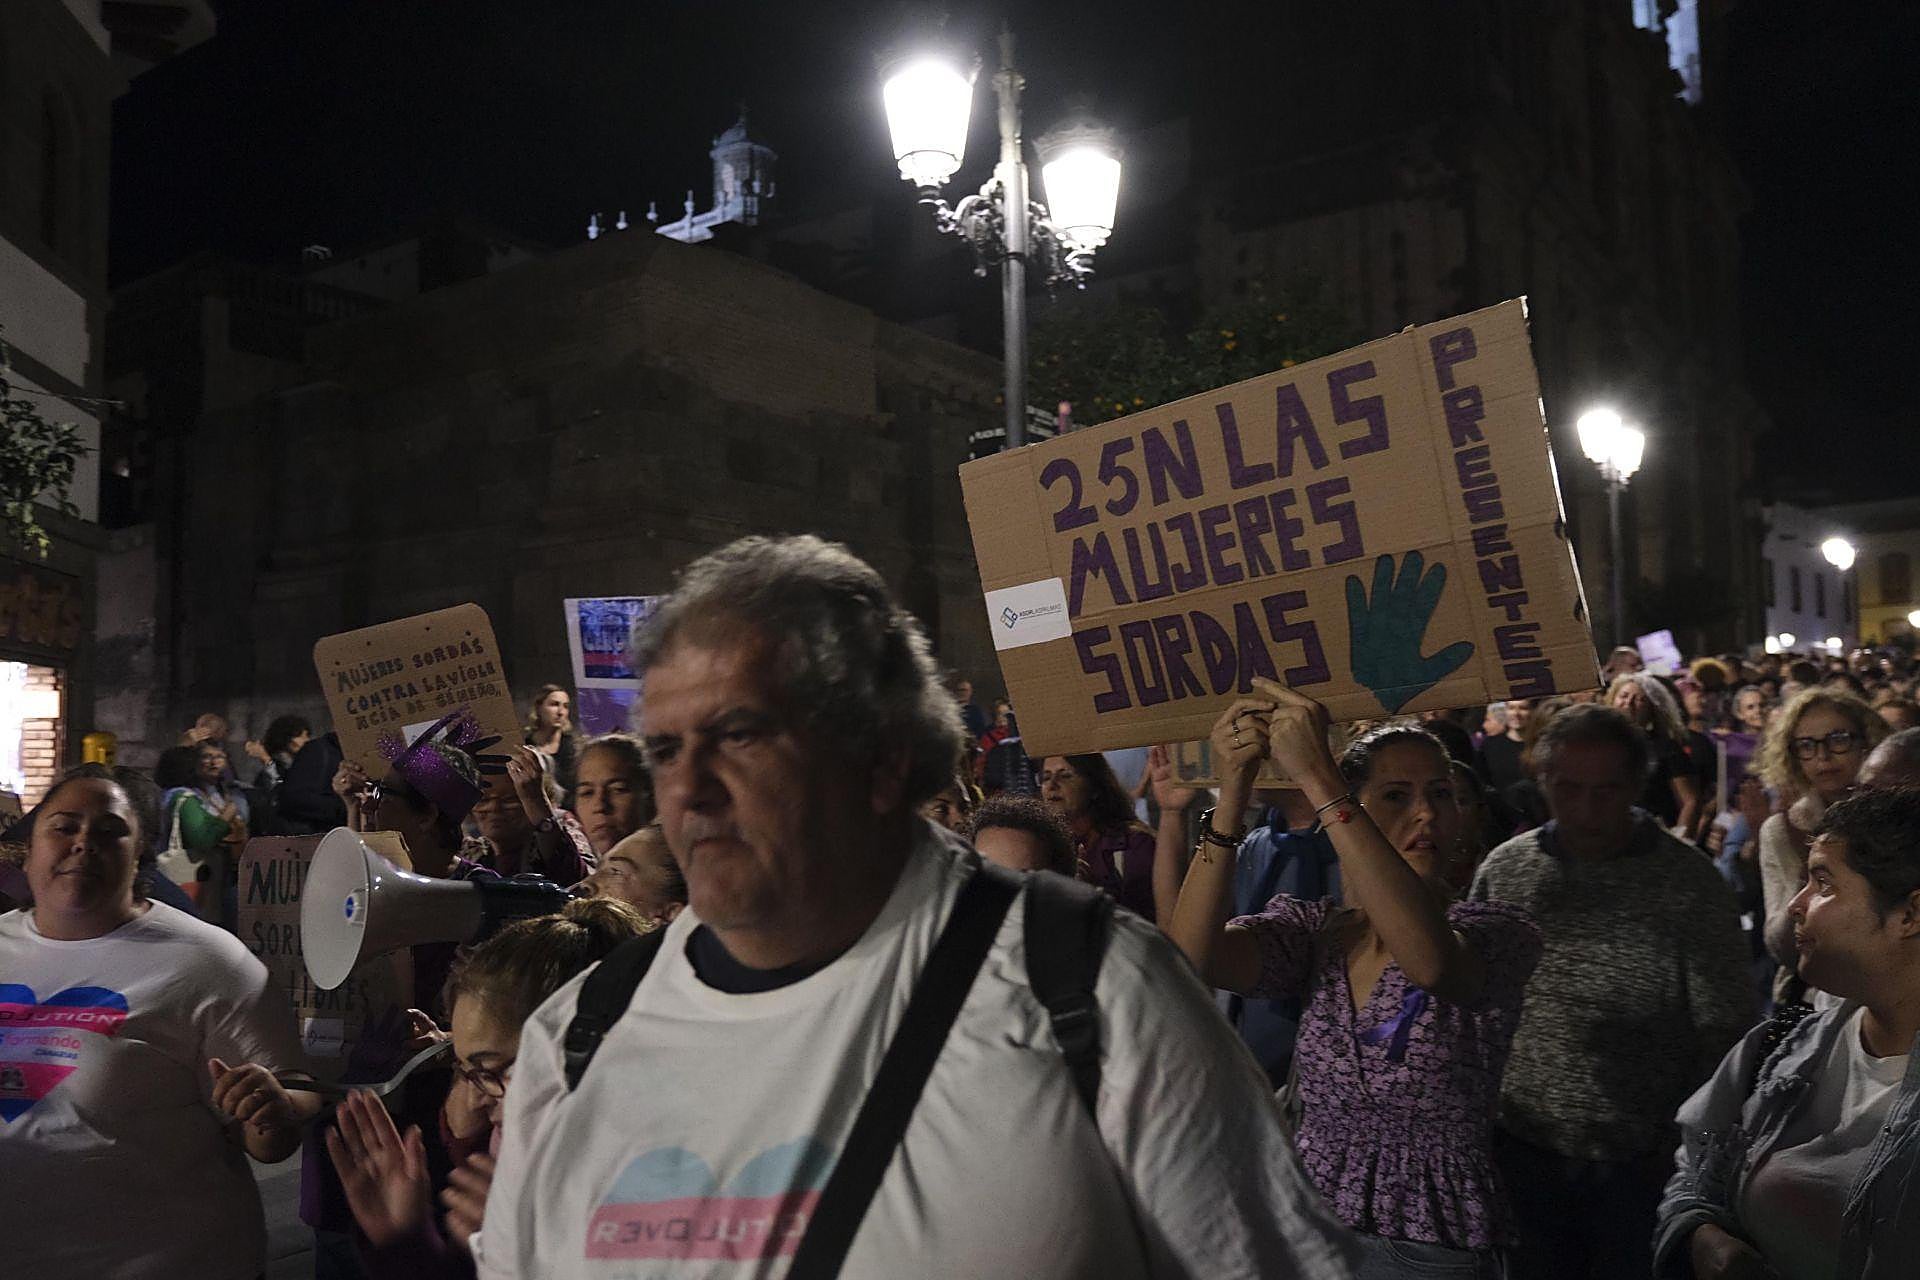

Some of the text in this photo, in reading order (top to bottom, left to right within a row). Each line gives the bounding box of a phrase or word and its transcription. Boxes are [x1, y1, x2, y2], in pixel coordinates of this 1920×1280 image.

[1215, 361, 1390, 490] LAS
[1068, 477, 1365, 618] MUJERES
[1429, 327, 1556, 700] PRESENTES
[346, 681, 418, 715] CONTRA
[412, 637, 485, 669] SORDAS
[1072, 590, 1332, 714] SORDAS
